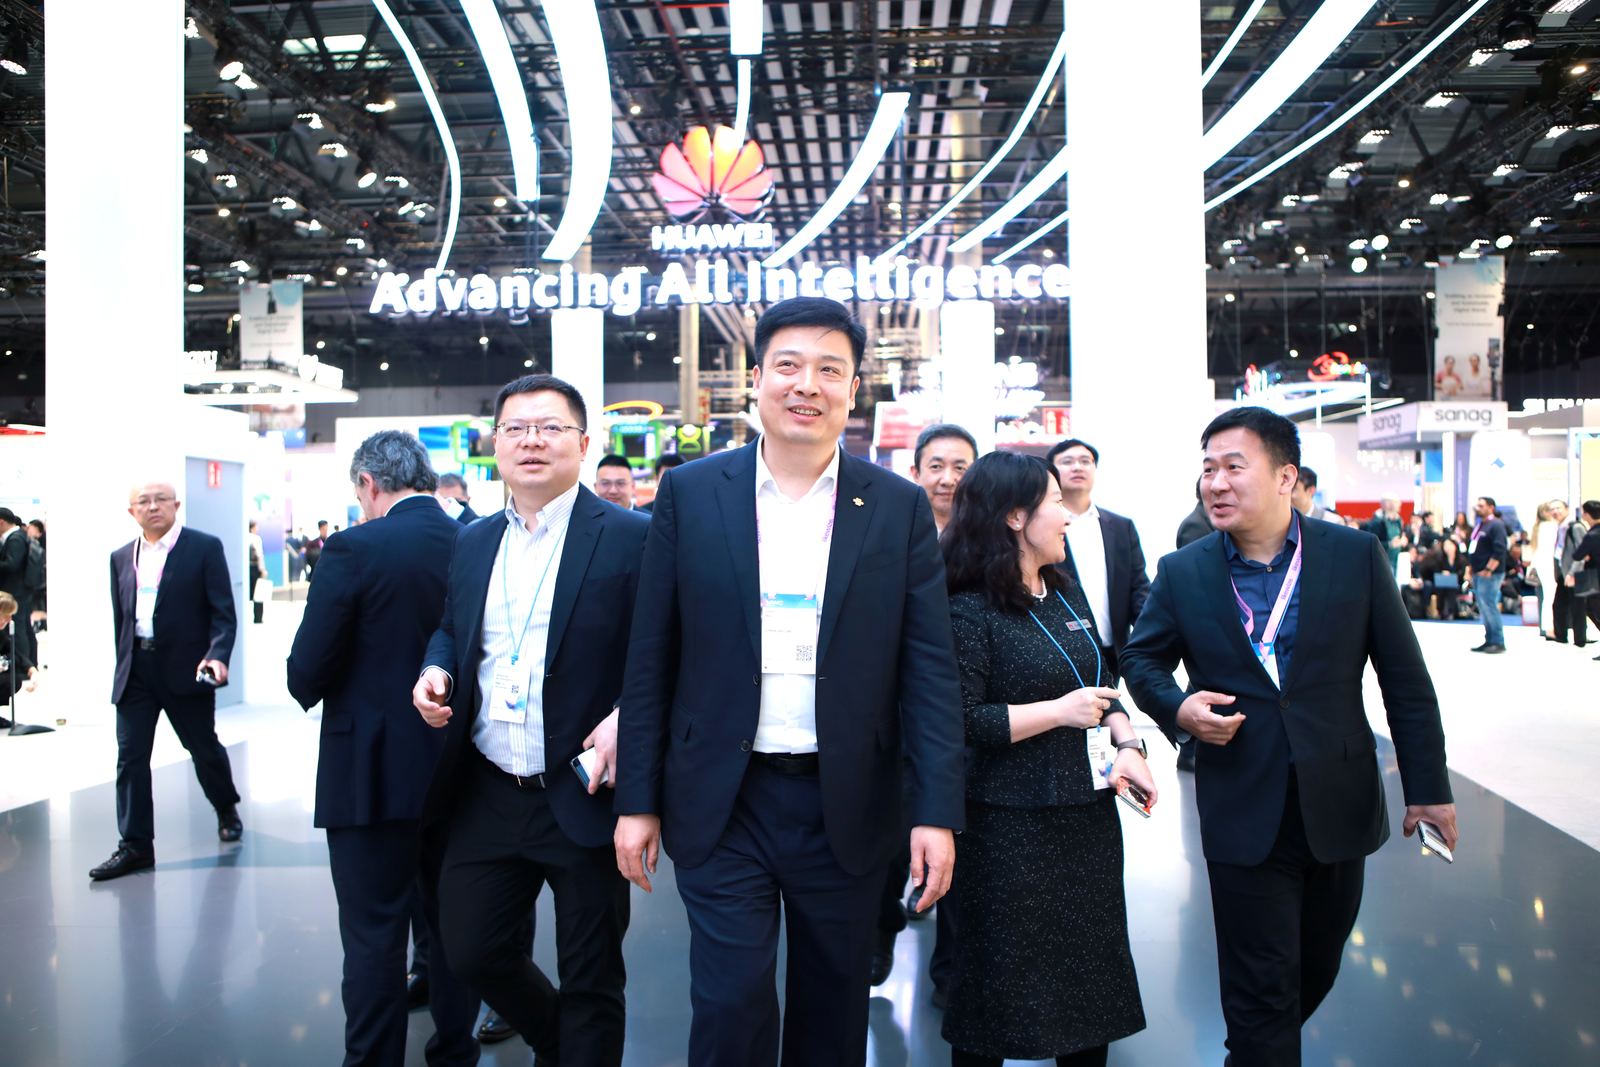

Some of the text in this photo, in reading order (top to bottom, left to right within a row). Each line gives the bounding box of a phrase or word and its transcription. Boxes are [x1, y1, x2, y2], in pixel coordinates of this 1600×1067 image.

[651, 222, 773, 250] HUAWEI
[369, 255, 1071, 316] Advancing All Intelligence
[1372, 412, 1402, 433] sanag
[1434, 408, 1493, 426] sanag
